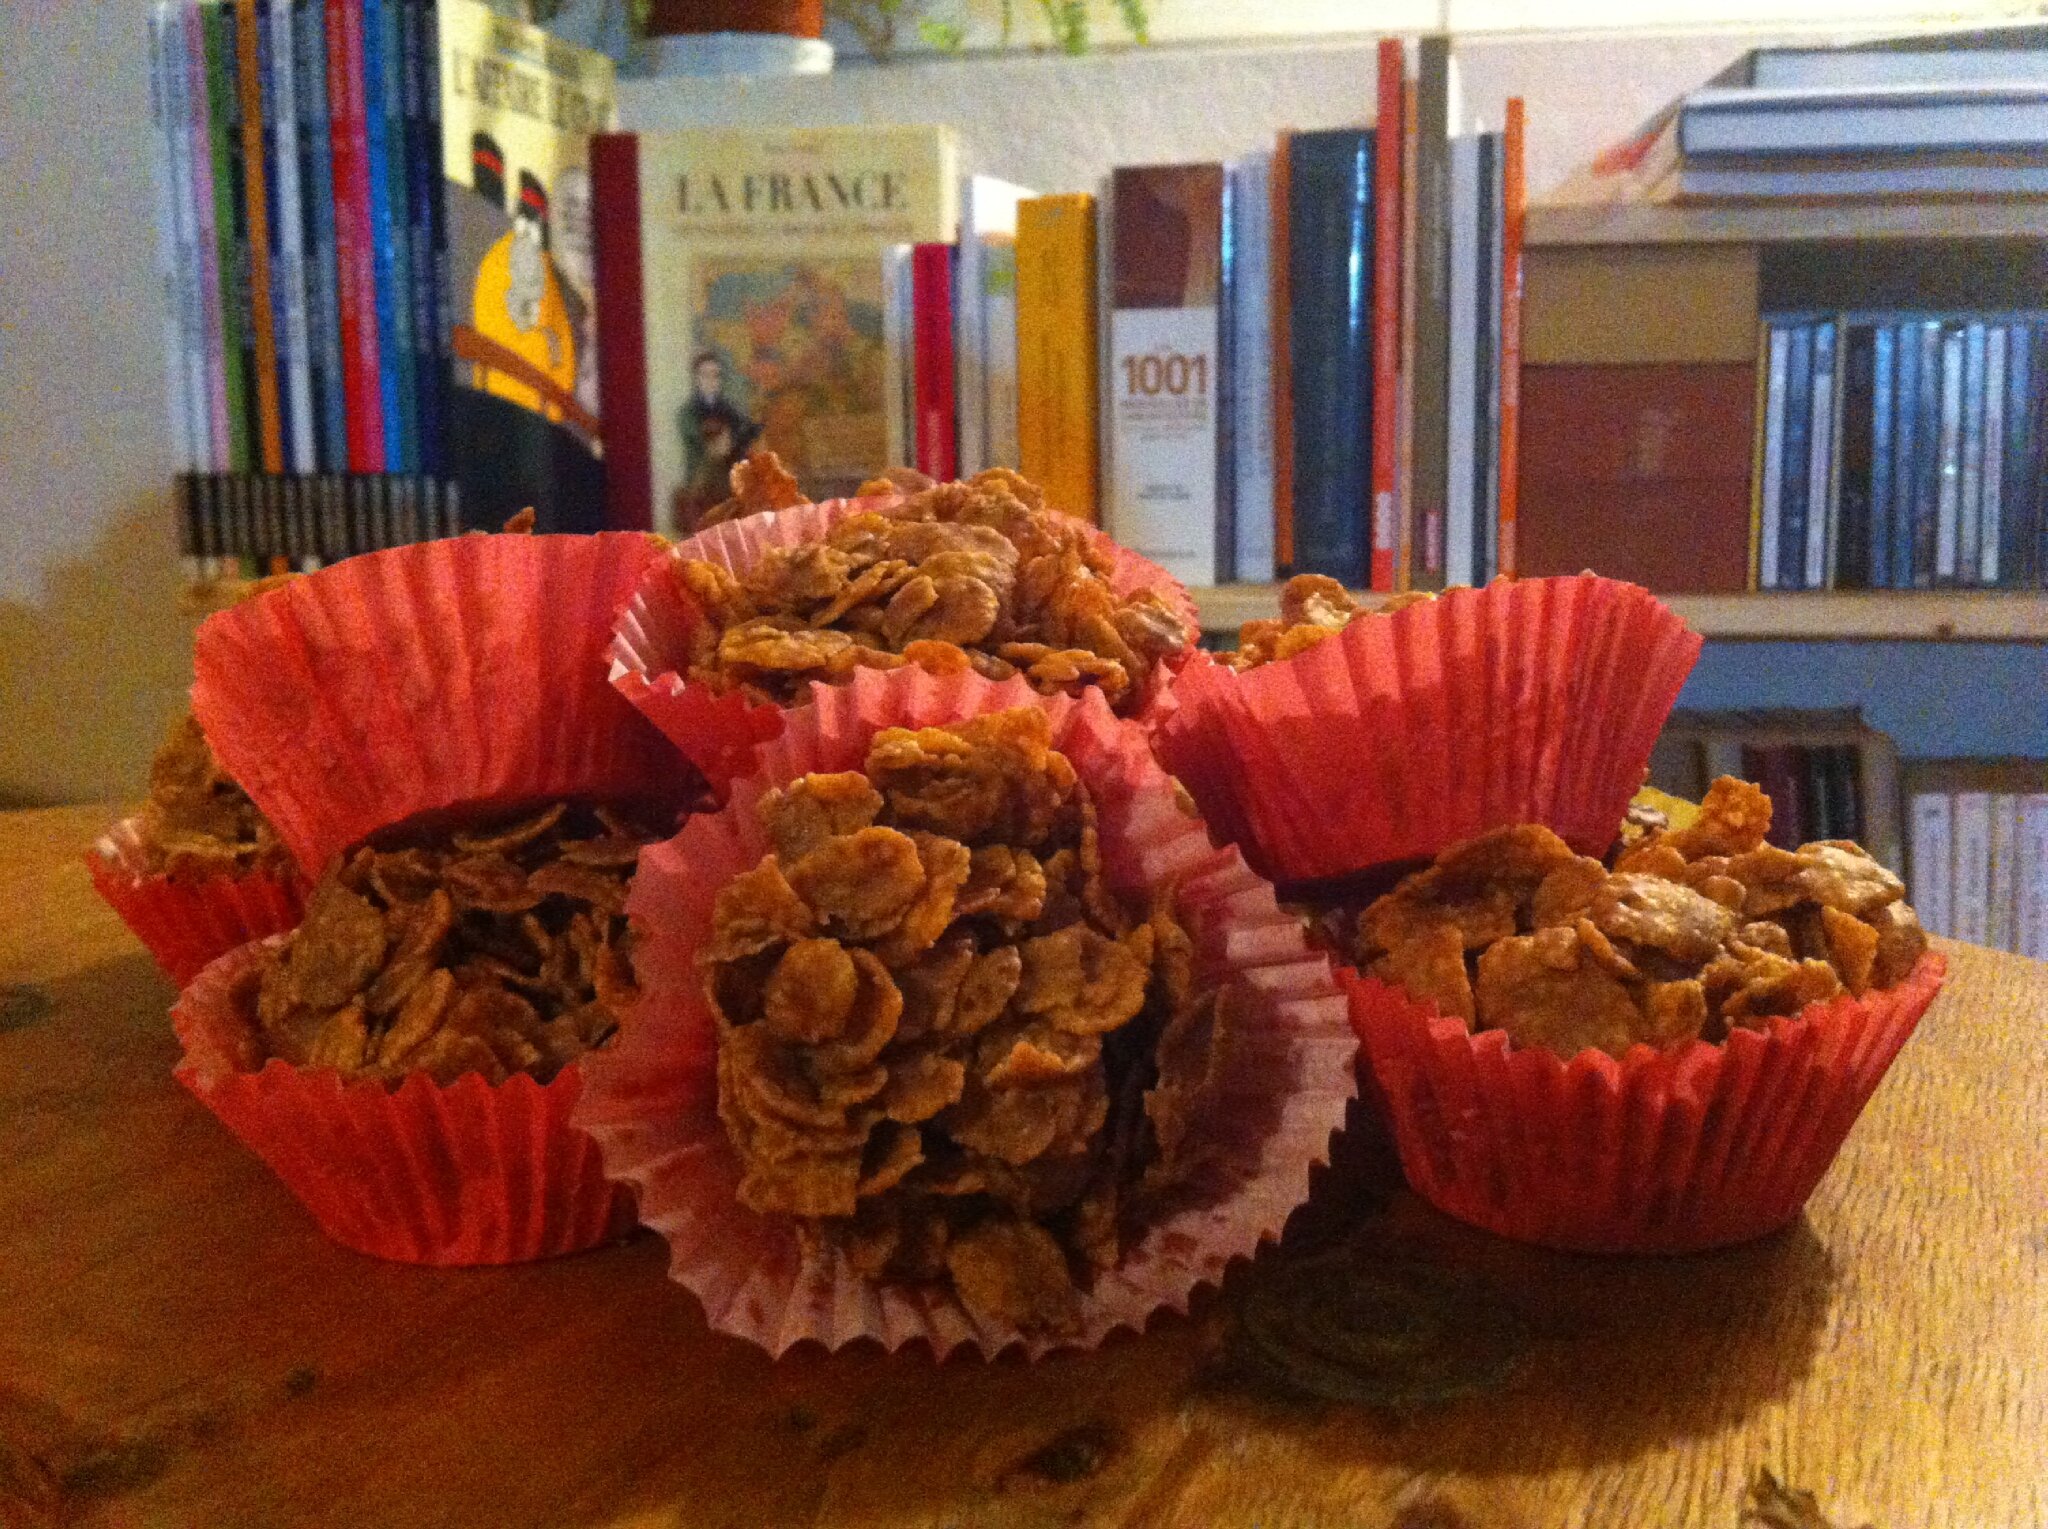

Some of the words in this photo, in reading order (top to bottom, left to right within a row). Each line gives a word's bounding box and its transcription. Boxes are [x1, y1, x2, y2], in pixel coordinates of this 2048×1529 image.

[676, 172, 730, 213] LA
[743, 170, 907, 212] FRANCE
[1123, 352, 1207, 396] 1001
